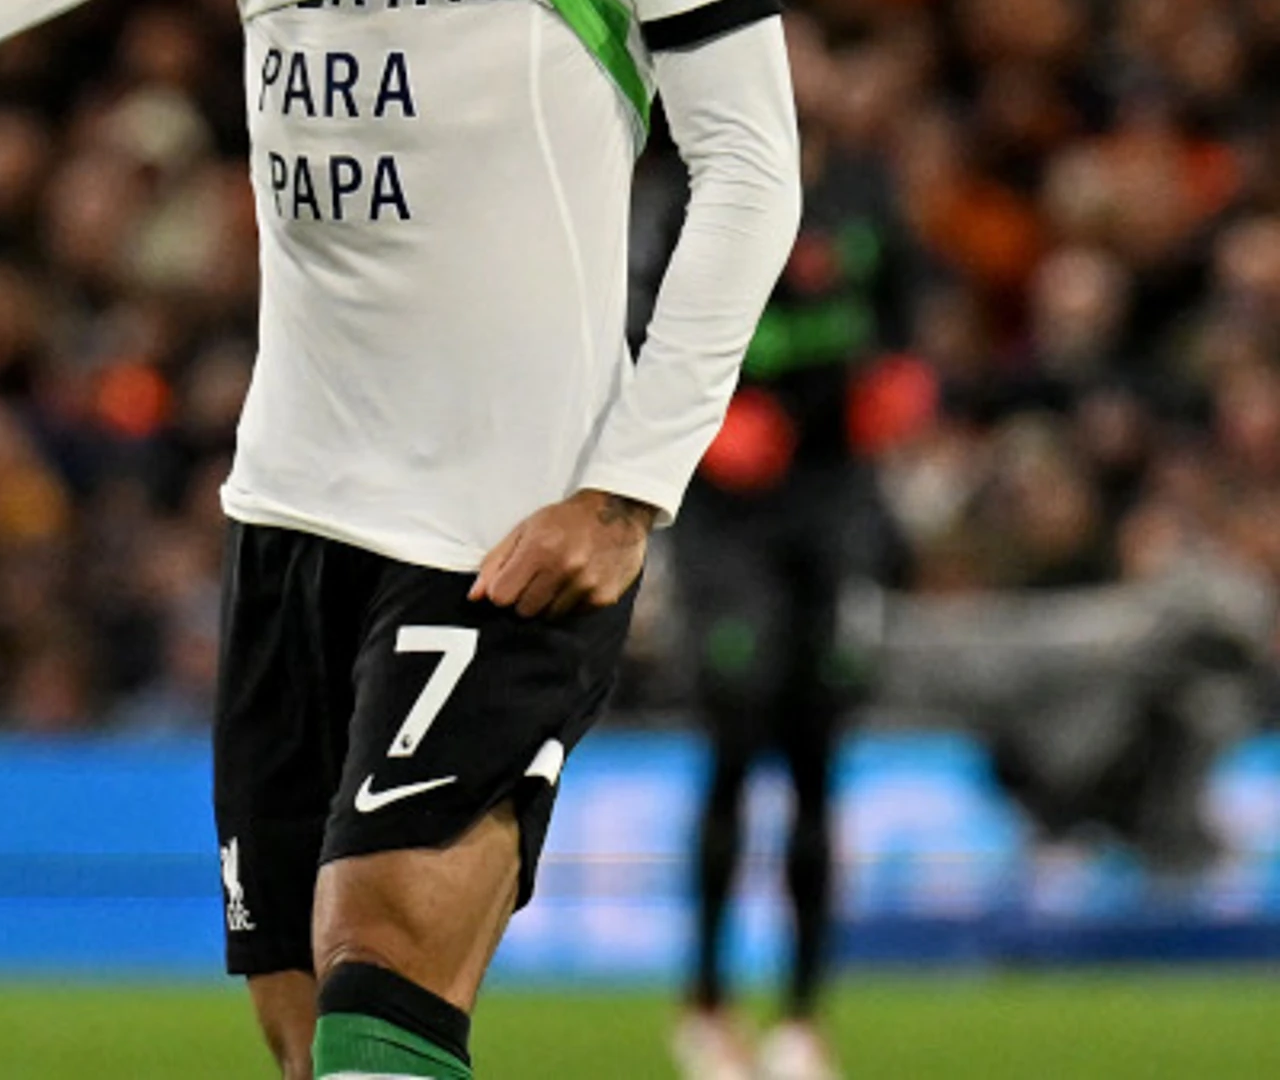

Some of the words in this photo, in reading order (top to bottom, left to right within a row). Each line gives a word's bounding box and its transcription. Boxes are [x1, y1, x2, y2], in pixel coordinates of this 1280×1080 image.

[258, 48, 417, 118] PARA
[268, 151, 411, 221] PAPA
[387, 625, 480, 758] 7
